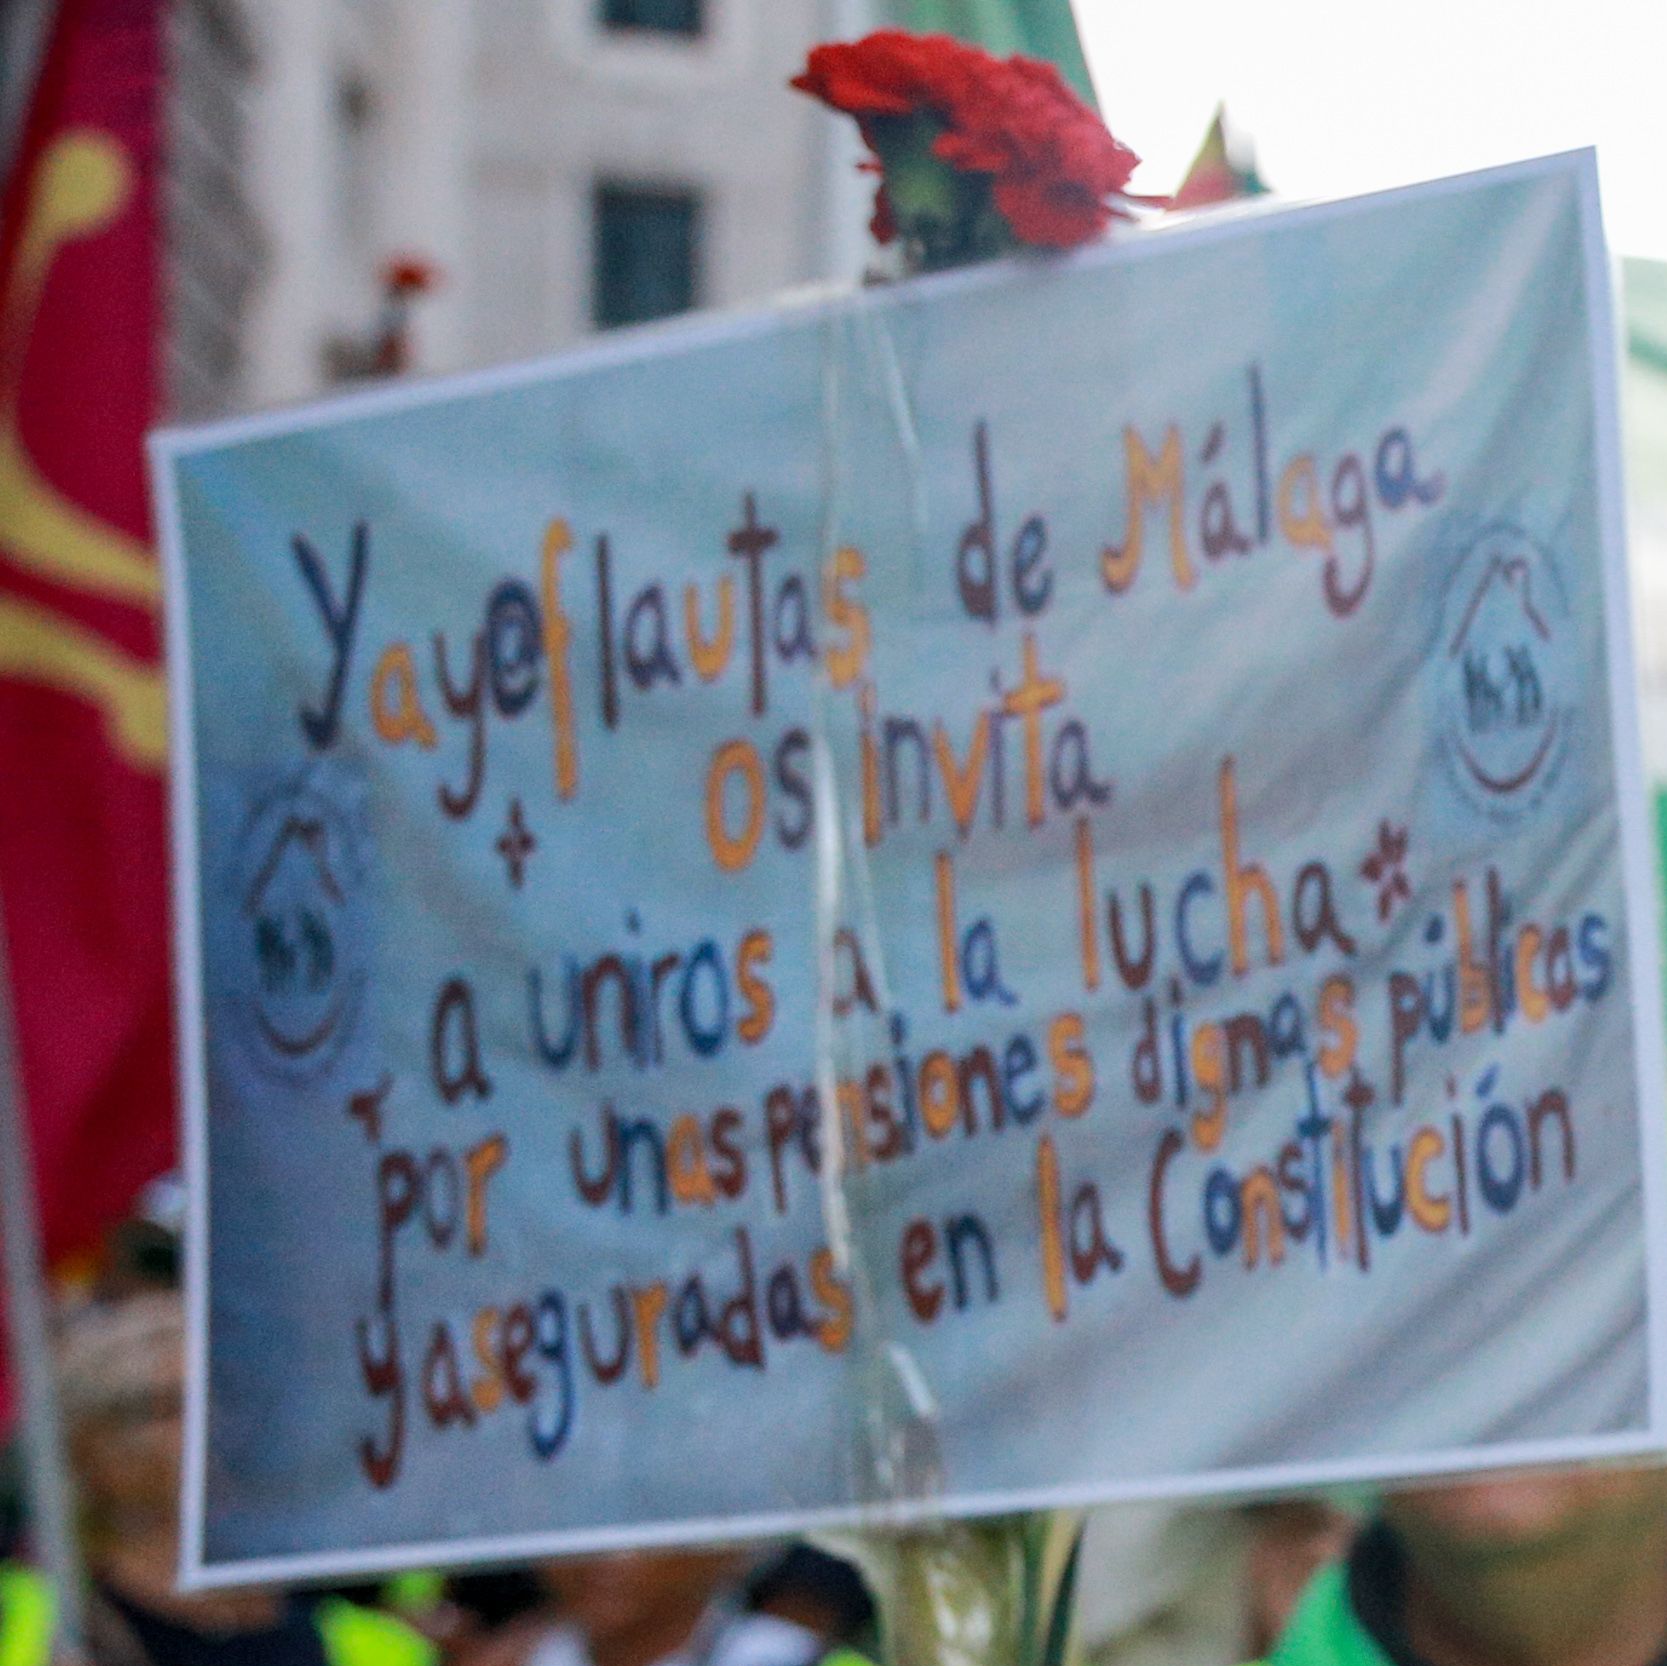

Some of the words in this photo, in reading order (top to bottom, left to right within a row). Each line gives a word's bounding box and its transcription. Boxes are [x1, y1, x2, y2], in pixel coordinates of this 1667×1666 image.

[956, 419, 1053, 631] de
[1101, 360, 1446, 618] Málaga
[704, 721, 815, 873] os
[856, 631, 1112, 847] invita
[375, 1131, 507, 1311] por
[571, 1104, 747, 1214] unas
[1130, 971, 1359, 1152] dignas
[1390, 866, 1614, 1106] públicas
[430, 979, 492, 1103] a
[528, 907, 774, 1073] uniros
[830, 926, 882, 1016] a
[935, 853, 1020, 1013] la
[901, 1210, 999, 1326] en
[1035, 1133, 1126, 1322] la
[1148, 1062, 1578, 1298] Constitución
